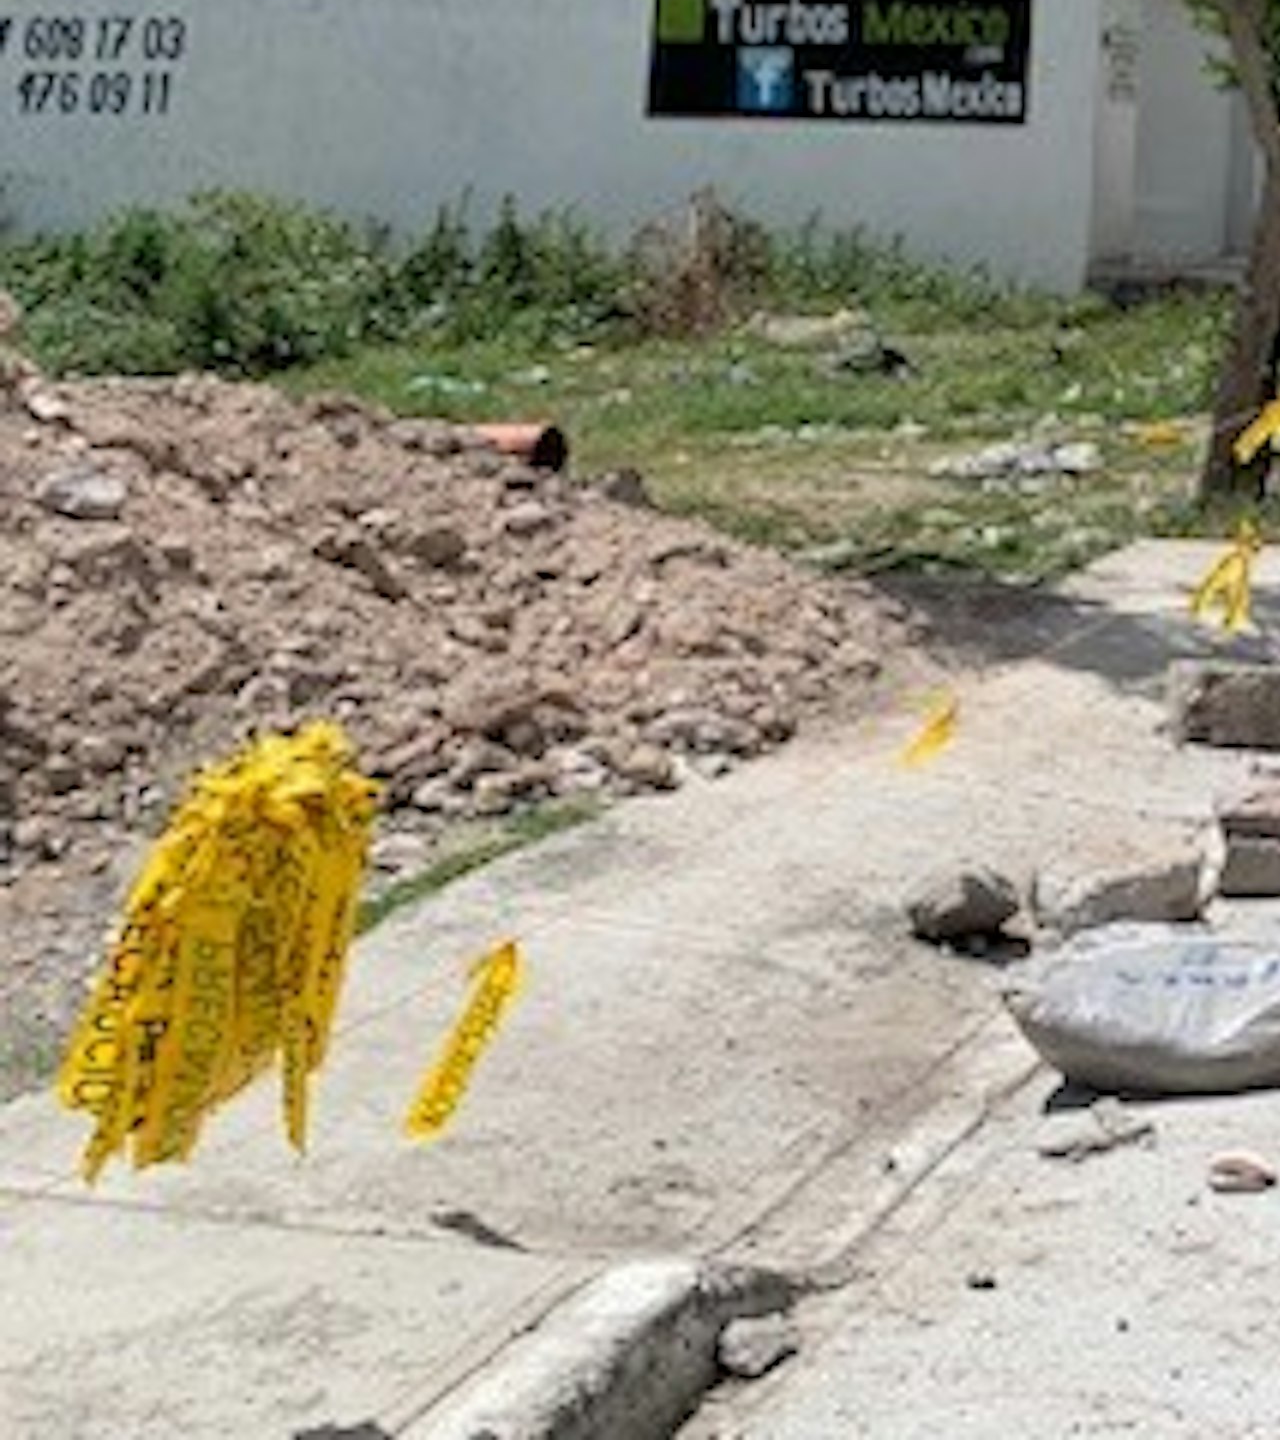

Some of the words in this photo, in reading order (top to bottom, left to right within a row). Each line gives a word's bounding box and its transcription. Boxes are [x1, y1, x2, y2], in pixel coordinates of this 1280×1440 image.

[95, 16, 132, 59] 17
[143, 16, 186, 60] 03
[143, 71, 171, 114] 11
